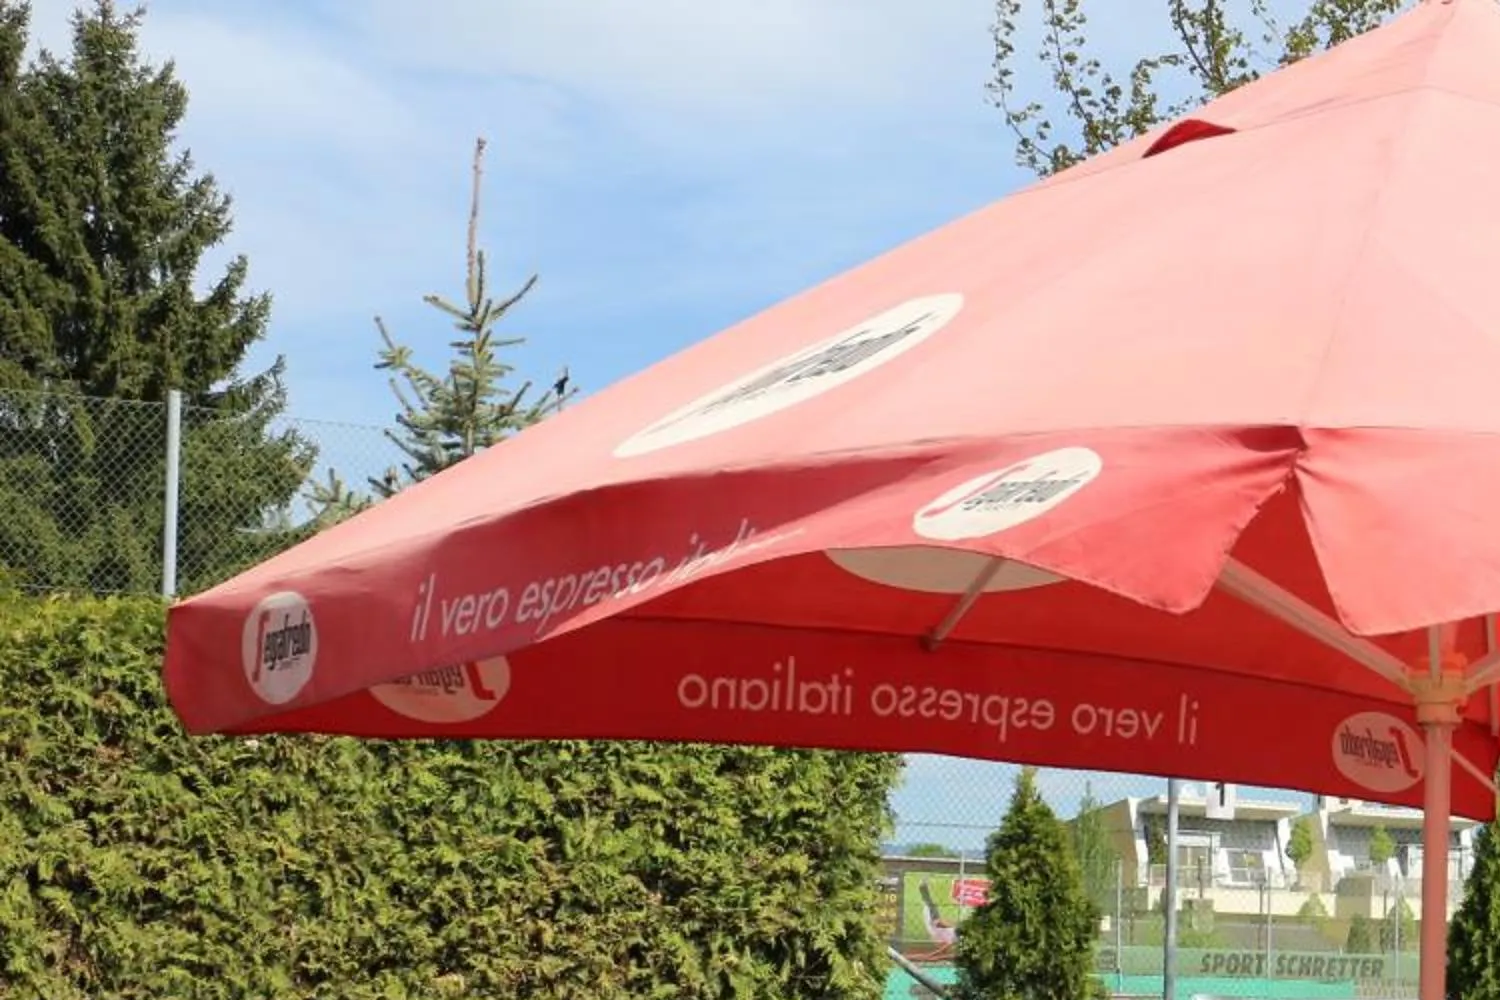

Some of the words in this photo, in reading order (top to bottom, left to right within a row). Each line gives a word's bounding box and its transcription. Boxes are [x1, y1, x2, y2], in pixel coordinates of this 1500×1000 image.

[411, 573, 435, 641] il
[441, 588, 507, 636] vero
[515, 556, 665, 634] espresso
[1200, 953, 1266, 975] SPORT
[1275, 954, 1385, 978] SCHRETTER
